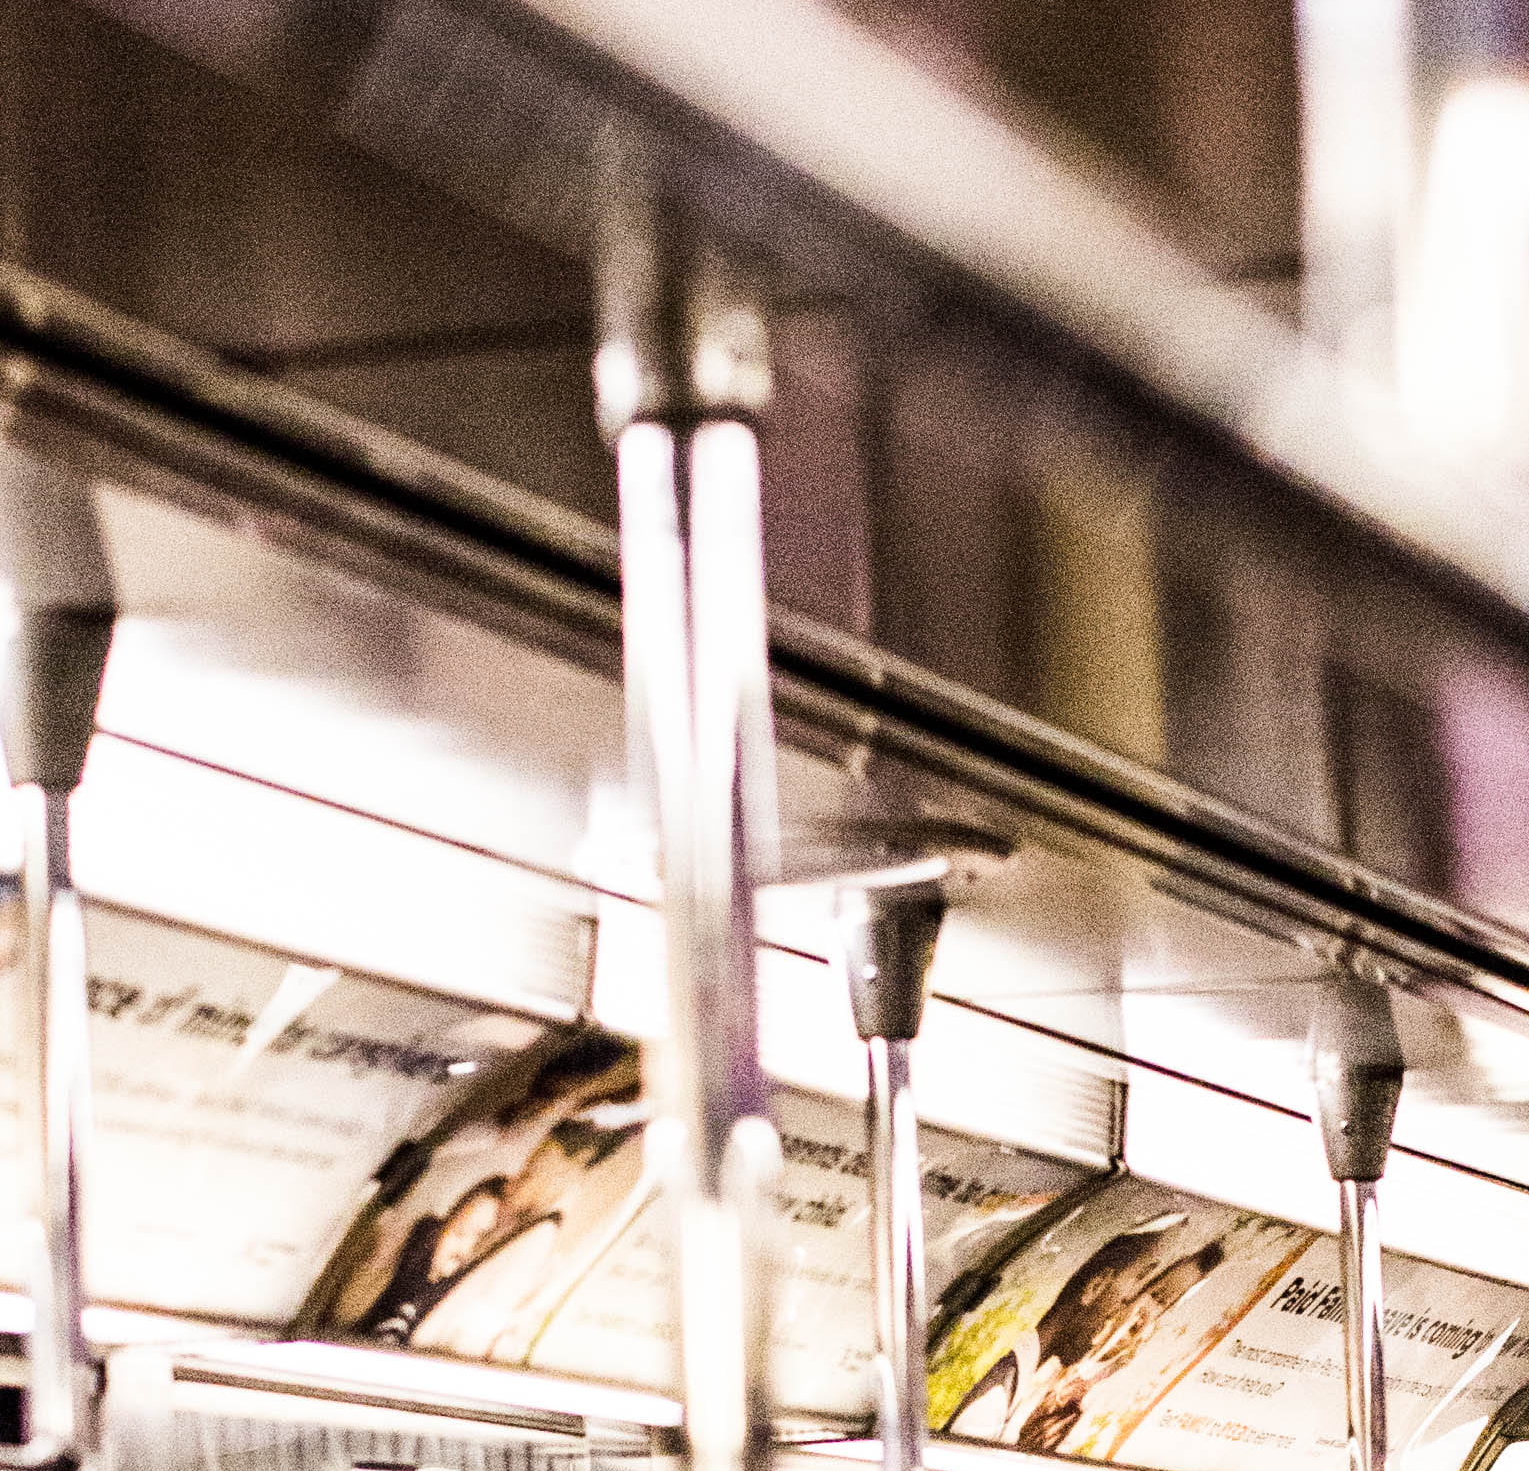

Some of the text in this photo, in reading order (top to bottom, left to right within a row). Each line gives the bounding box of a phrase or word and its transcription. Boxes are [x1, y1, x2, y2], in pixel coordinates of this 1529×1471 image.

[1270, 1277, 1329, 1315] Paid
[1404, 1307, 1431, 1340] is
[1420, 1318, 1484, 1359] coming
